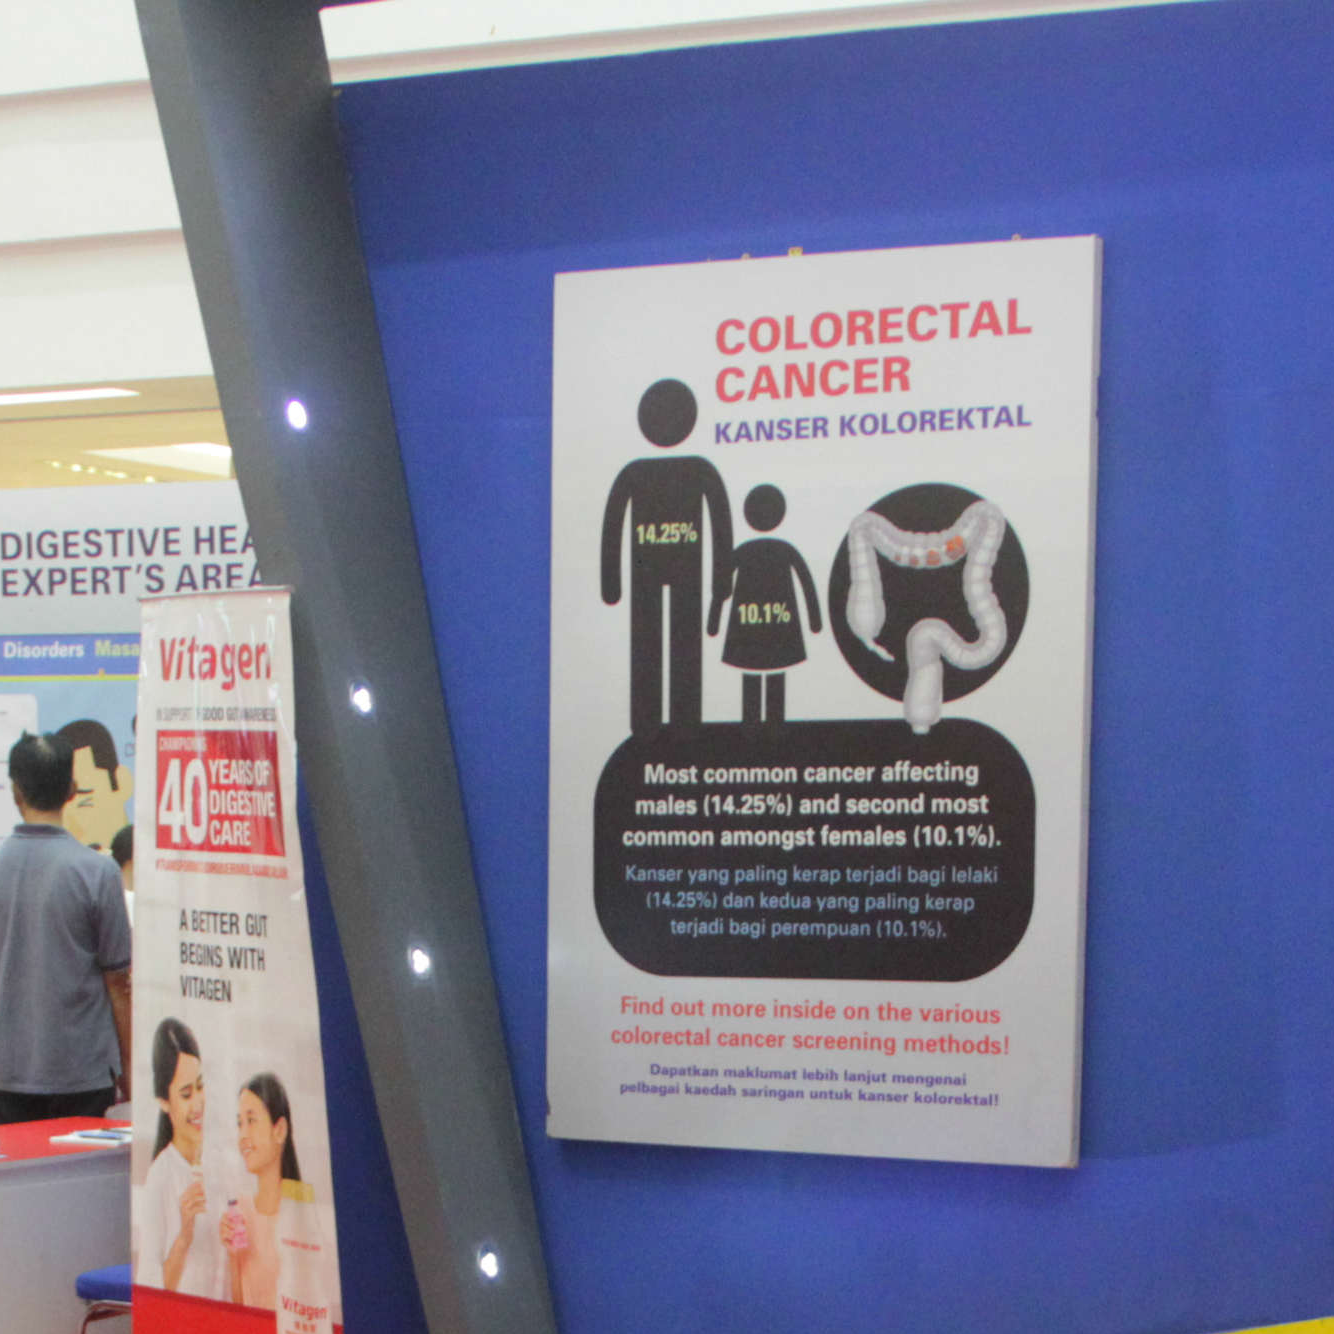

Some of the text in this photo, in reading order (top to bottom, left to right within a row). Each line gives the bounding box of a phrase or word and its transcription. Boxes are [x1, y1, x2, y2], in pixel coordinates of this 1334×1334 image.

[716, 298, 1033, 356] COLORECTAL
[716, 356, 912, 404] CANCER
[715, 405, 1033, 444] KANSER KOLOREKTAL
[0, 527, 180, 561] DIGESTIVE
[637, 523, 697, 546] 14.25%
[2, 563, 165, 598] EXPERT'S
[738, 603, 791, 625] 10.1%
[4, 641, 84, 658] Disorders
[643, 760, 979, 786] Most common cancer affecting
[158, 758, 208, 844] 40
[208, 760, 252, 786] YEARS
[210, 790, 276, 817] DIGESTIVE
[635, 793, 989, 817] males (14.25%) and second most
[210, 819, 251, 846] CARE
[622, 825, 1002, 851] common amongst females (10.1%).
[625, 865, 998, 888] Kanser yang paling kerap terjadi bagi lelaki
[646, 891, 974, 914] (14.25%) dan kedua yang paling kerap
[179, 908, 267, 938] A BETTER GUT
[670, 919, 723, 937] terjadi
[729, 919, 766, 938] bagi
[771, 923, 871, 939] perempuan
[180, 941, 265, 971] BEGINS WITH
[180, 974, 232, 1002] VITAGEN
[620, 996, 1001, 1025] Find out more inside on the various
[610, 1027, 1010, 1056] colorectal cancer screening methods!
[650, 1063, 967, 1088] Dapatkan maklumat lebih lanjut mengenai
[620, 1081, 680, 1098] pelbagai
[685, 1082, 736, 1097] kaedah
[741, 1085, 805, 1101] saringan
[810, 1086, 853, 1101] untuk
[858, 1088, 909, 1103] kanser
